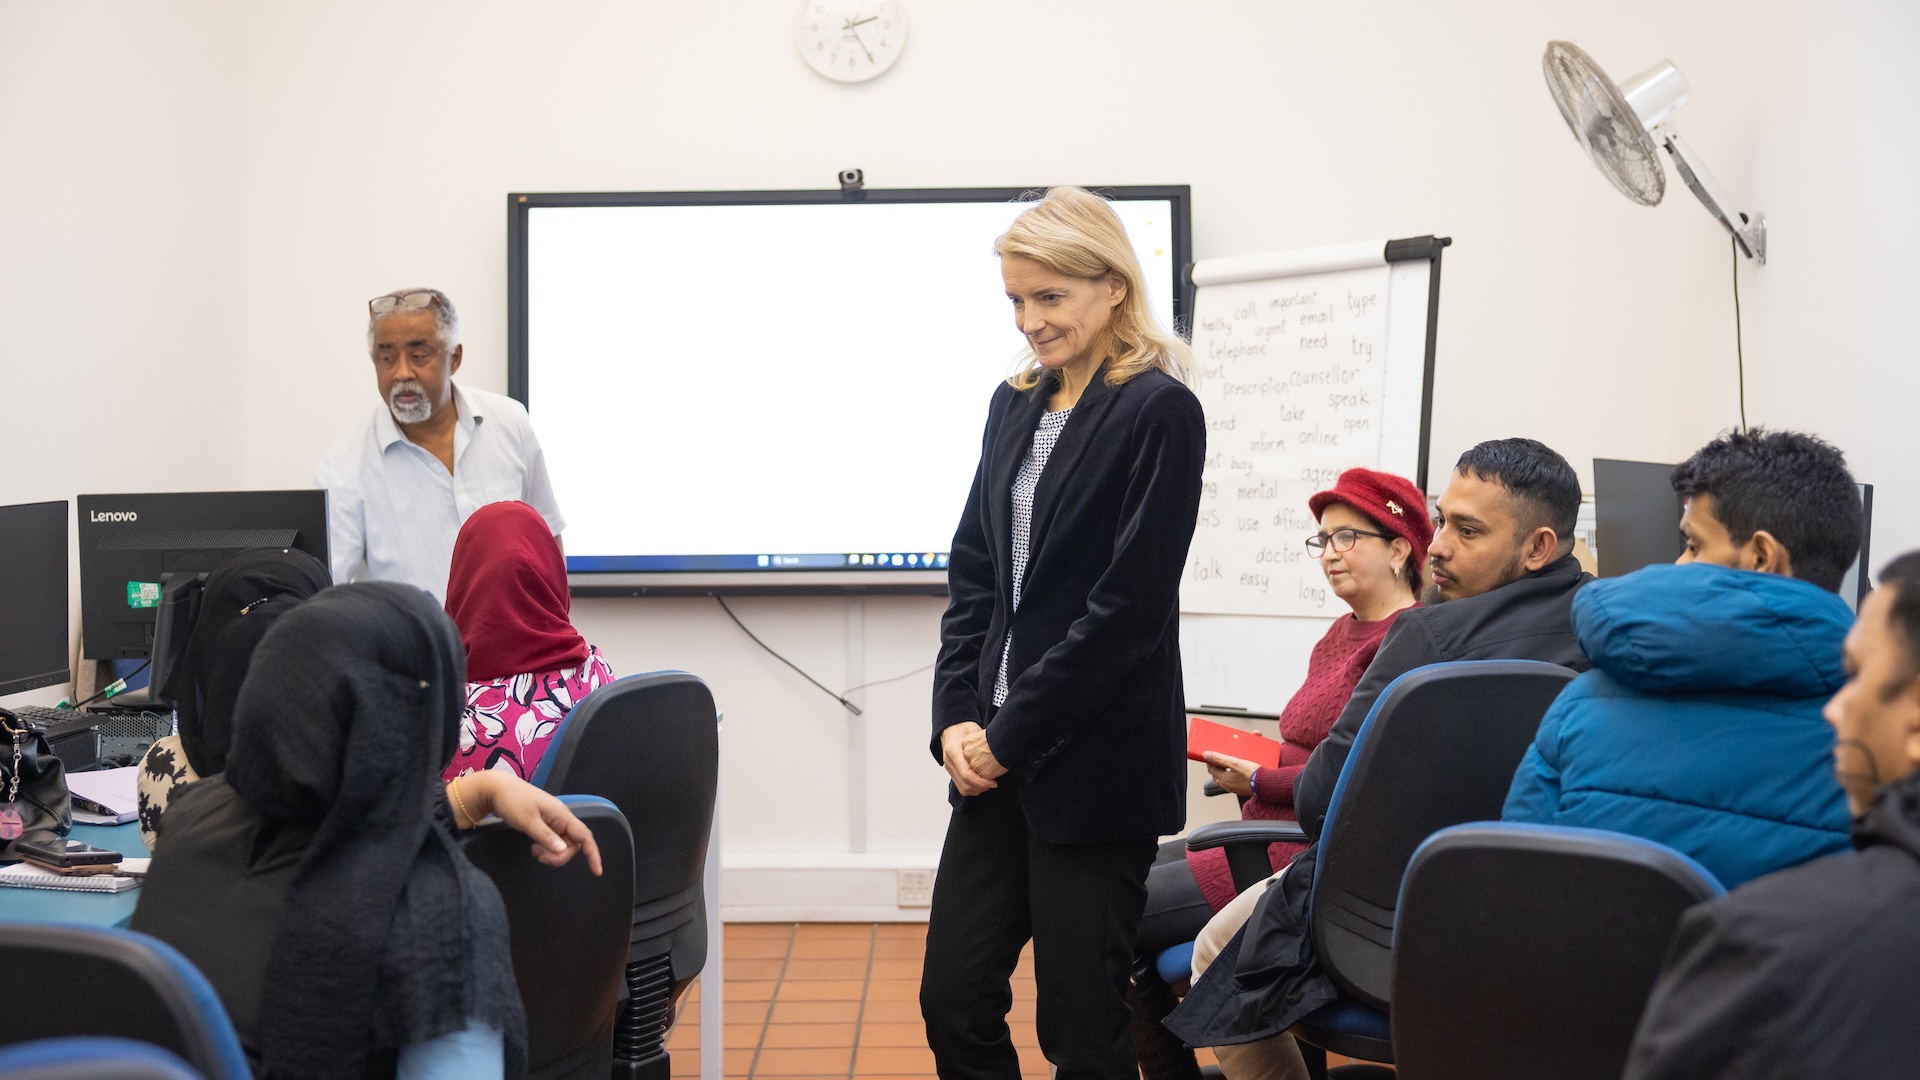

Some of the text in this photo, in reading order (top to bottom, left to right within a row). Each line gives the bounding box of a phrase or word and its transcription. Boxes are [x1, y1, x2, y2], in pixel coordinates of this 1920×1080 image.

[1233, 301, 1258, 320] call
[1269, 291, 1318, 313] important
[1347, 289, 1377, 318] type
[1300, 303, 1334, 326] email
[1254, 316, 1287, 341] urgent
[1300, 331, 1328, 349] need
[1209, 338, 1267, 363] telephone
[1352, 335, 1372, 363] try
[1289, 363, 1361, 387] counsellor
[1223, 374, 1290, 401] prescription
[1328, 387, 1370, 412] speak
[1280, 402, 1305, 422] take
[1298, 422, 1339, 446] online
[1343, 418, 1370, 436] open
[1250, 431, 1287, 453] inform
[1230, 454, 1253, 477] busy
[1237, 480, 1278, 500] mental
[91, 510, 137, 522] Lenovo
[1256, 543, 1303, 564] doctor
[1194, 556, 1224, 581] talk
[1240, 573, 1270, 593] easy
[1298, 578, 1326, 608] long
